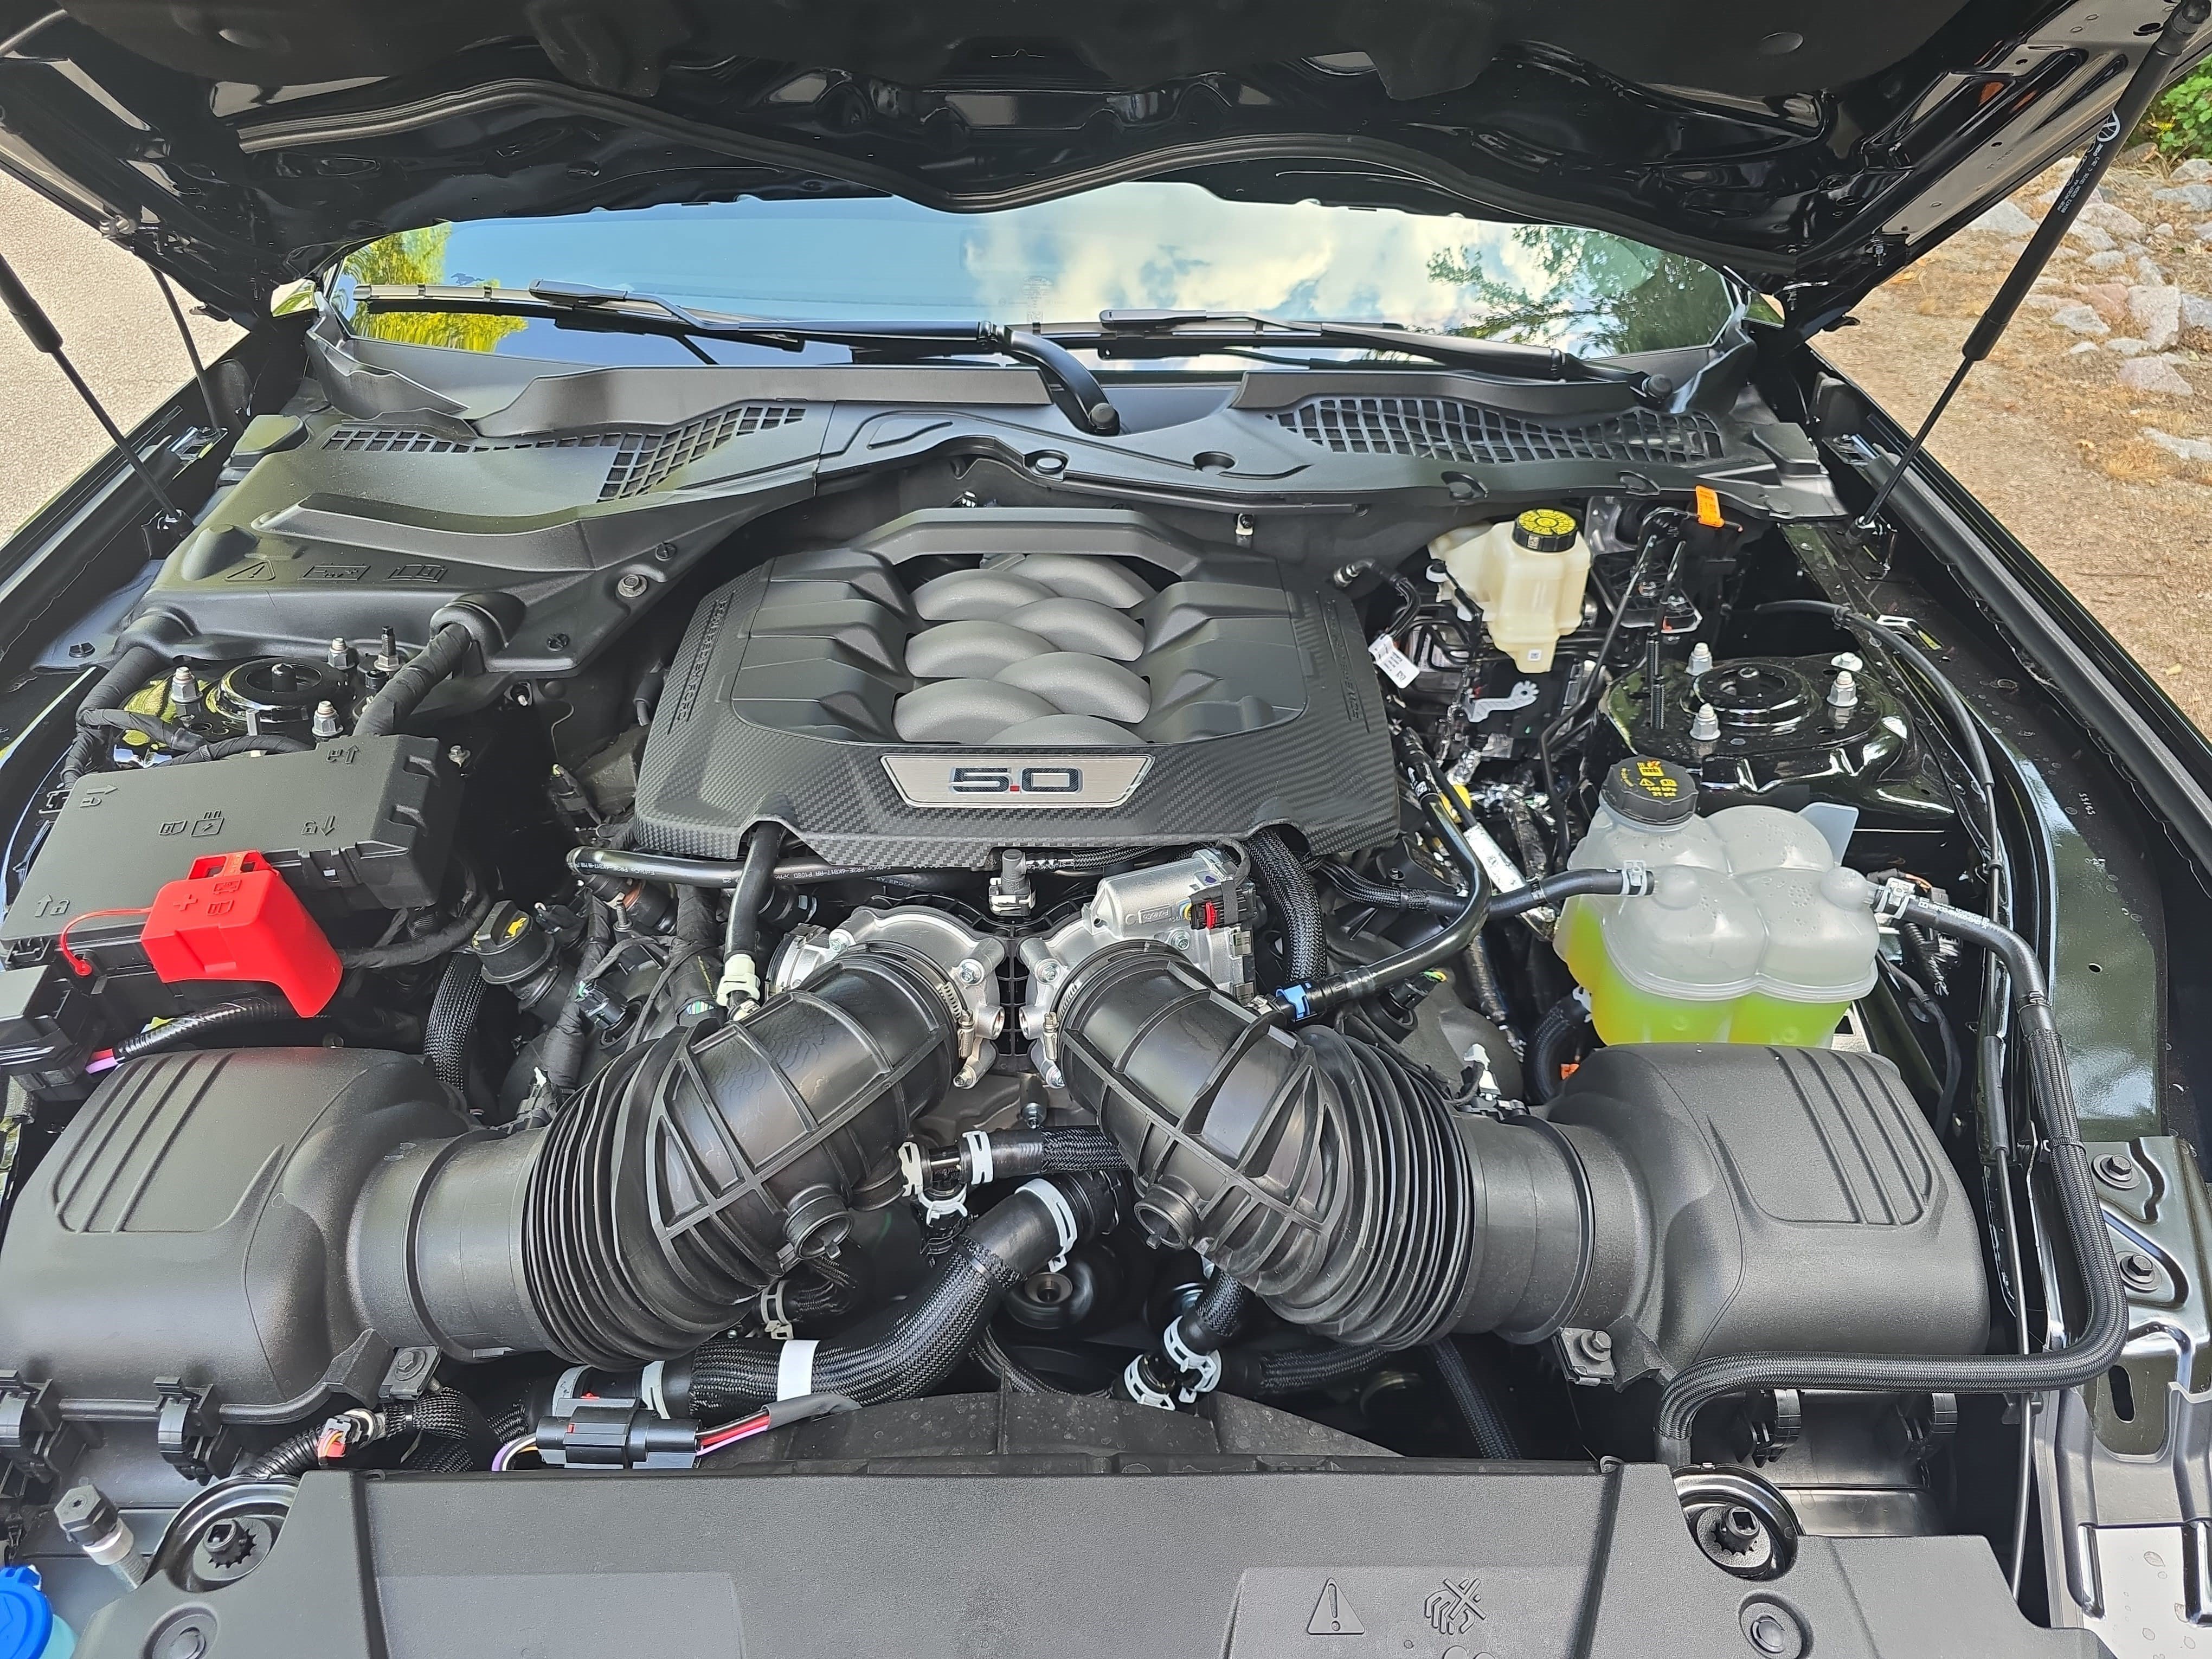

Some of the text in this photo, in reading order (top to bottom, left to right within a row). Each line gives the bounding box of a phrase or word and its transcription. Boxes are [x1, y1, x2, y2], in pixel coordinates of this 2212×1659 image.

[677, 600, 727, 721] POWERED BY FORD
[949, 767, 1083, 794] 5.0
